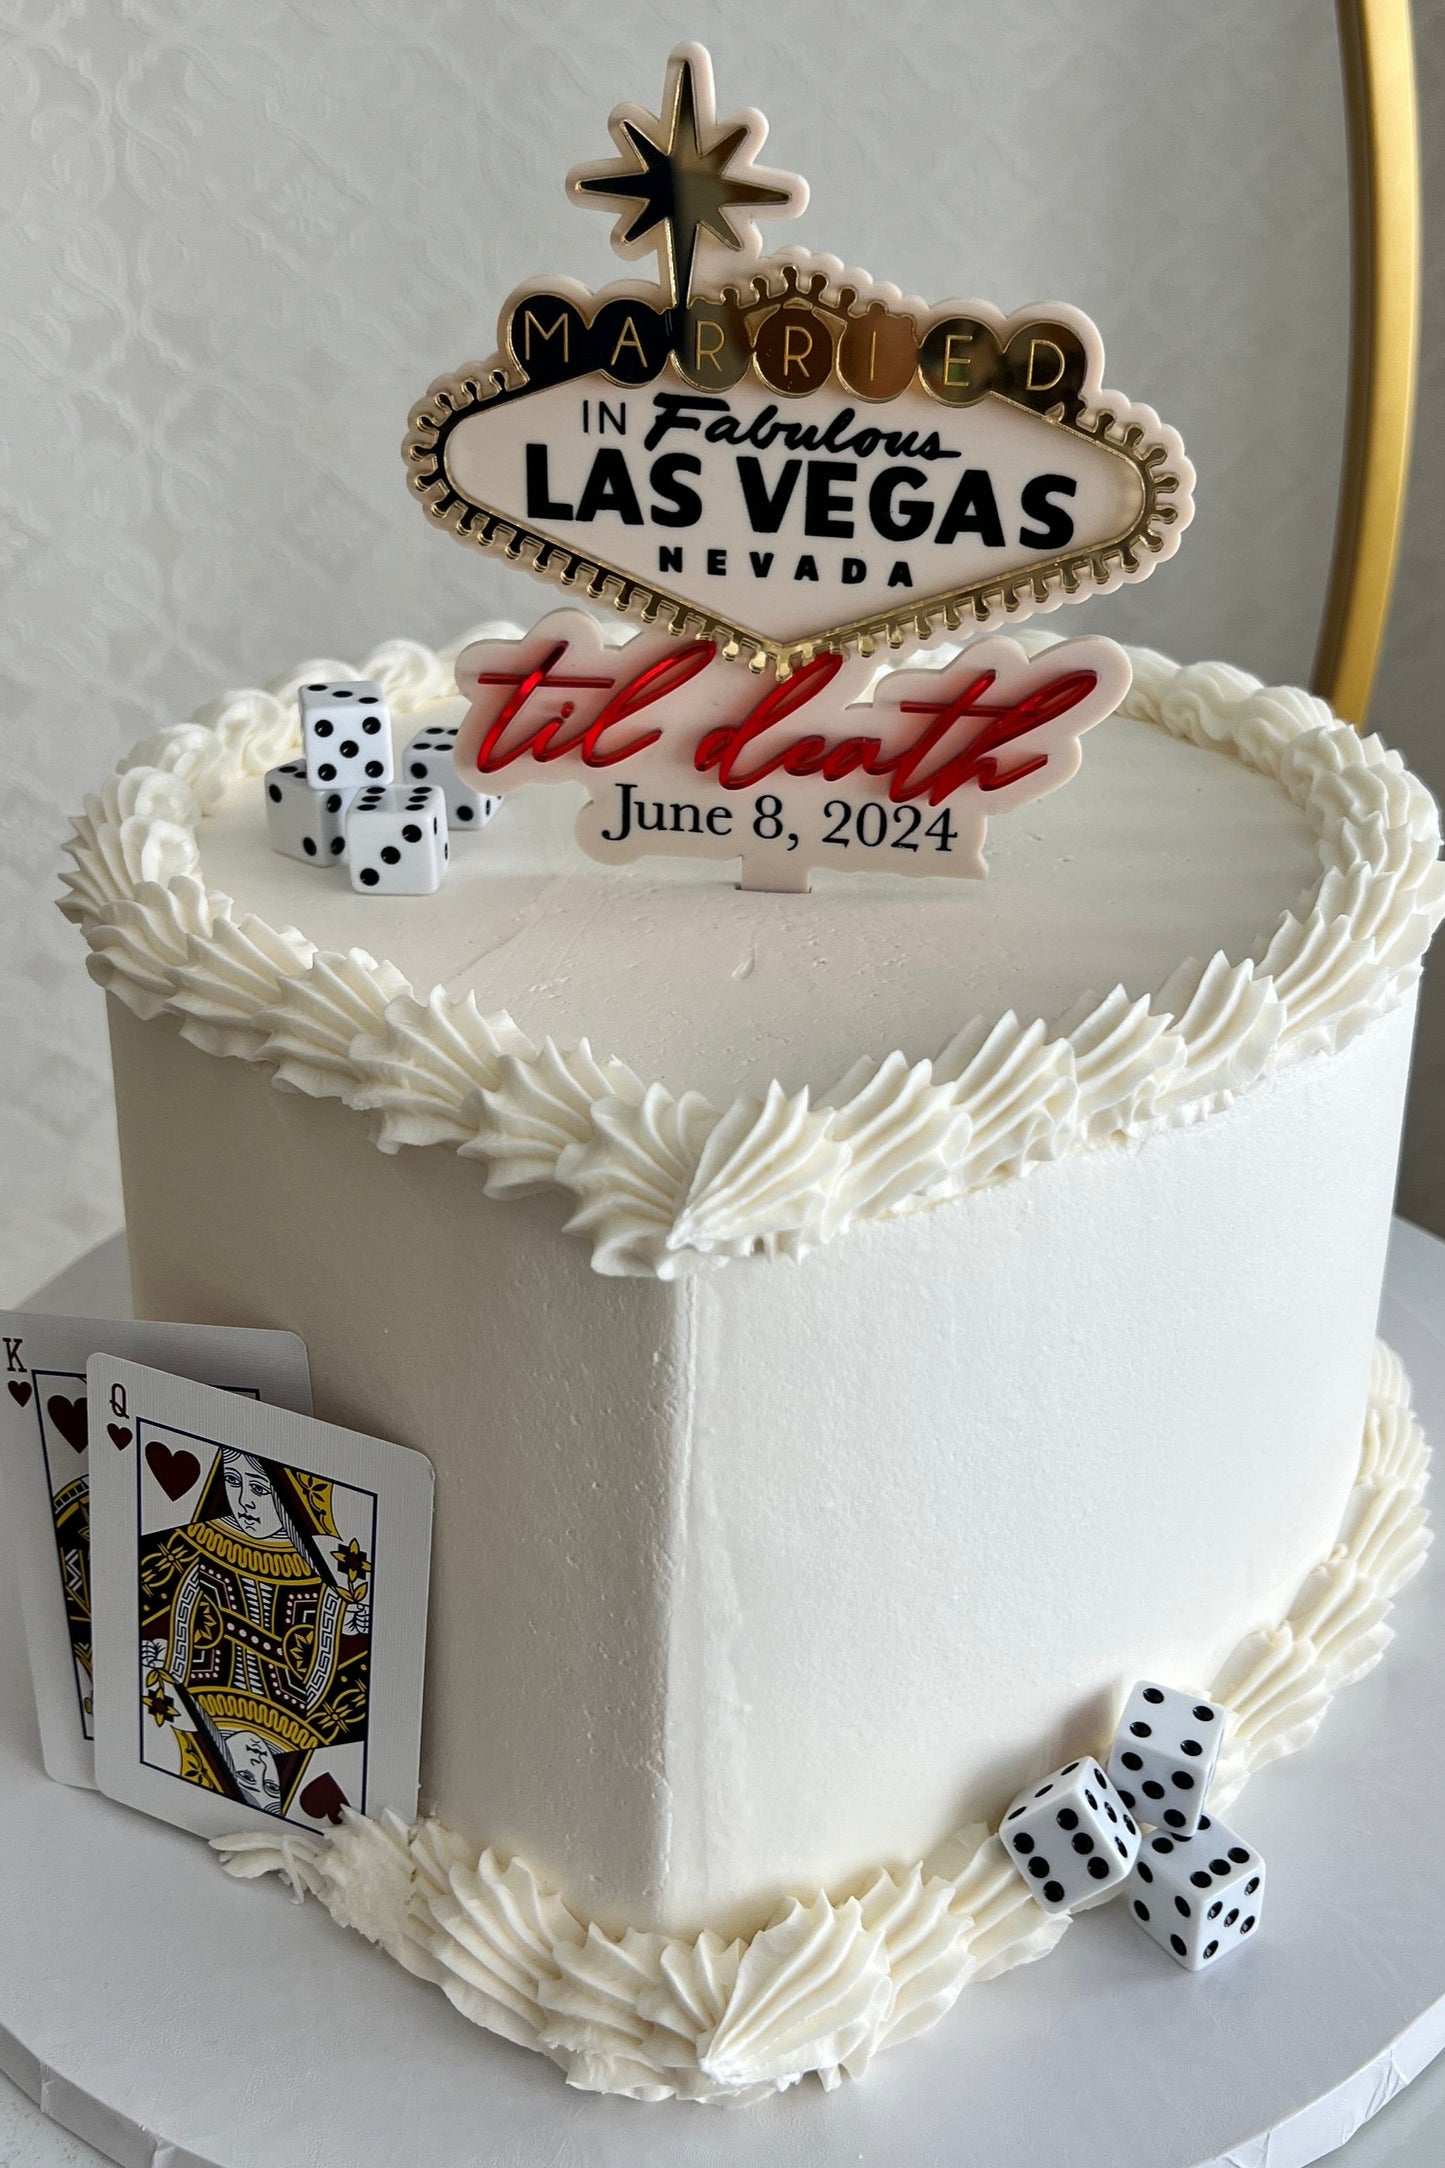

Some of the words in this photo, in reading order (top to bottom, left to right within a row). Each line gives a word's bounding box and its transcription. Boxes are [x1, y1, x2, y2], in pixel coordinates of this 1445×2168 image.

[522, 309, 1066, 392] MARRIED
[582, 398, 628, 436] IN
[643, 393, 962, 461] Fabulous
[524, 443, 703, 528] LAS
[734, 456, 1077, 551] VEGAS
[658, 545, 914, 589] NEVADA
[476, 639, 718, 774] til
[693, 653, 1098, 807] death
[600, 782, 733, 842] June
[752, 794, 800, 851] 8,
[822, 798, 959, 853] 2024
[3, 1338, 27, 1372] K
[109, 1383, 129, 1419] Q
